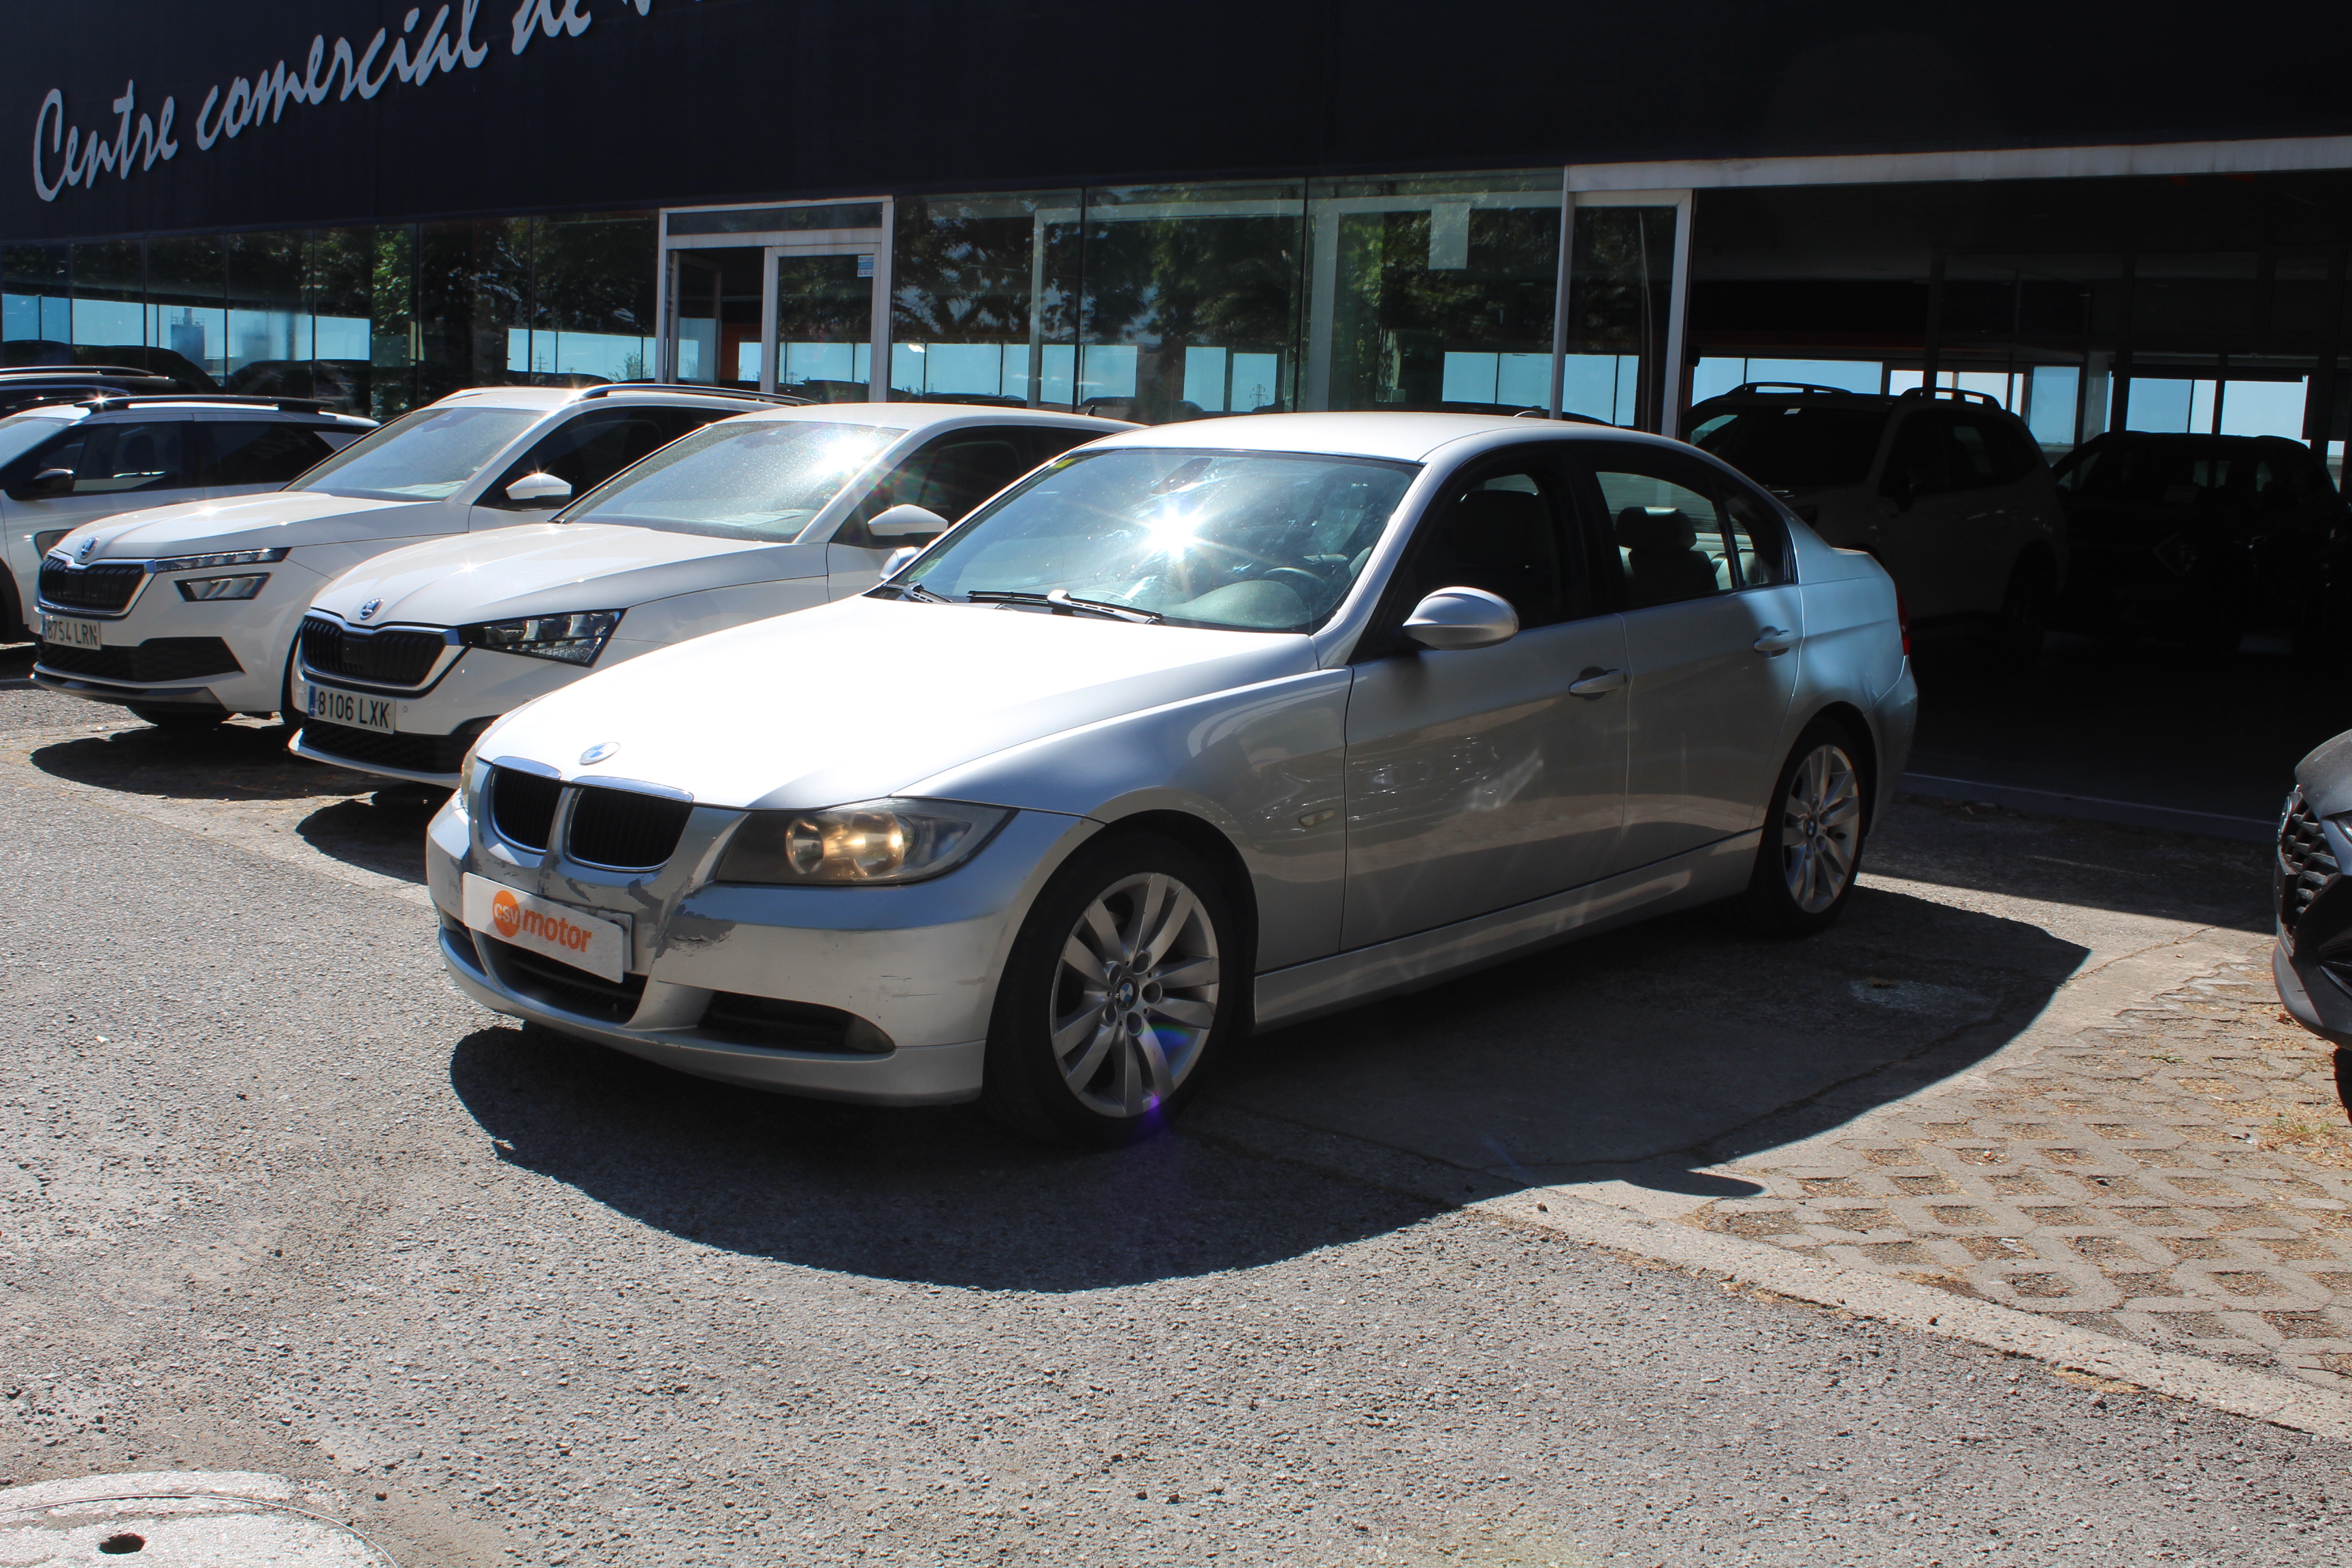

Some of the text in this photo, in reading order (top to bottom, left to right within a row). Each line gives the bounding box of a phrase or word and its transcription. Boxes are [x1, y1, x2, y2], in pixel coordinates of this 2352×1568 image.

[33, 80, 178, 201] Centre
[196, 0, 489, 150] comercial
[47, 620, 98, 646] 8754 LRN
[318, 691, 390, 728] 8106 LXK
[522, 909, 592, 952] motor
